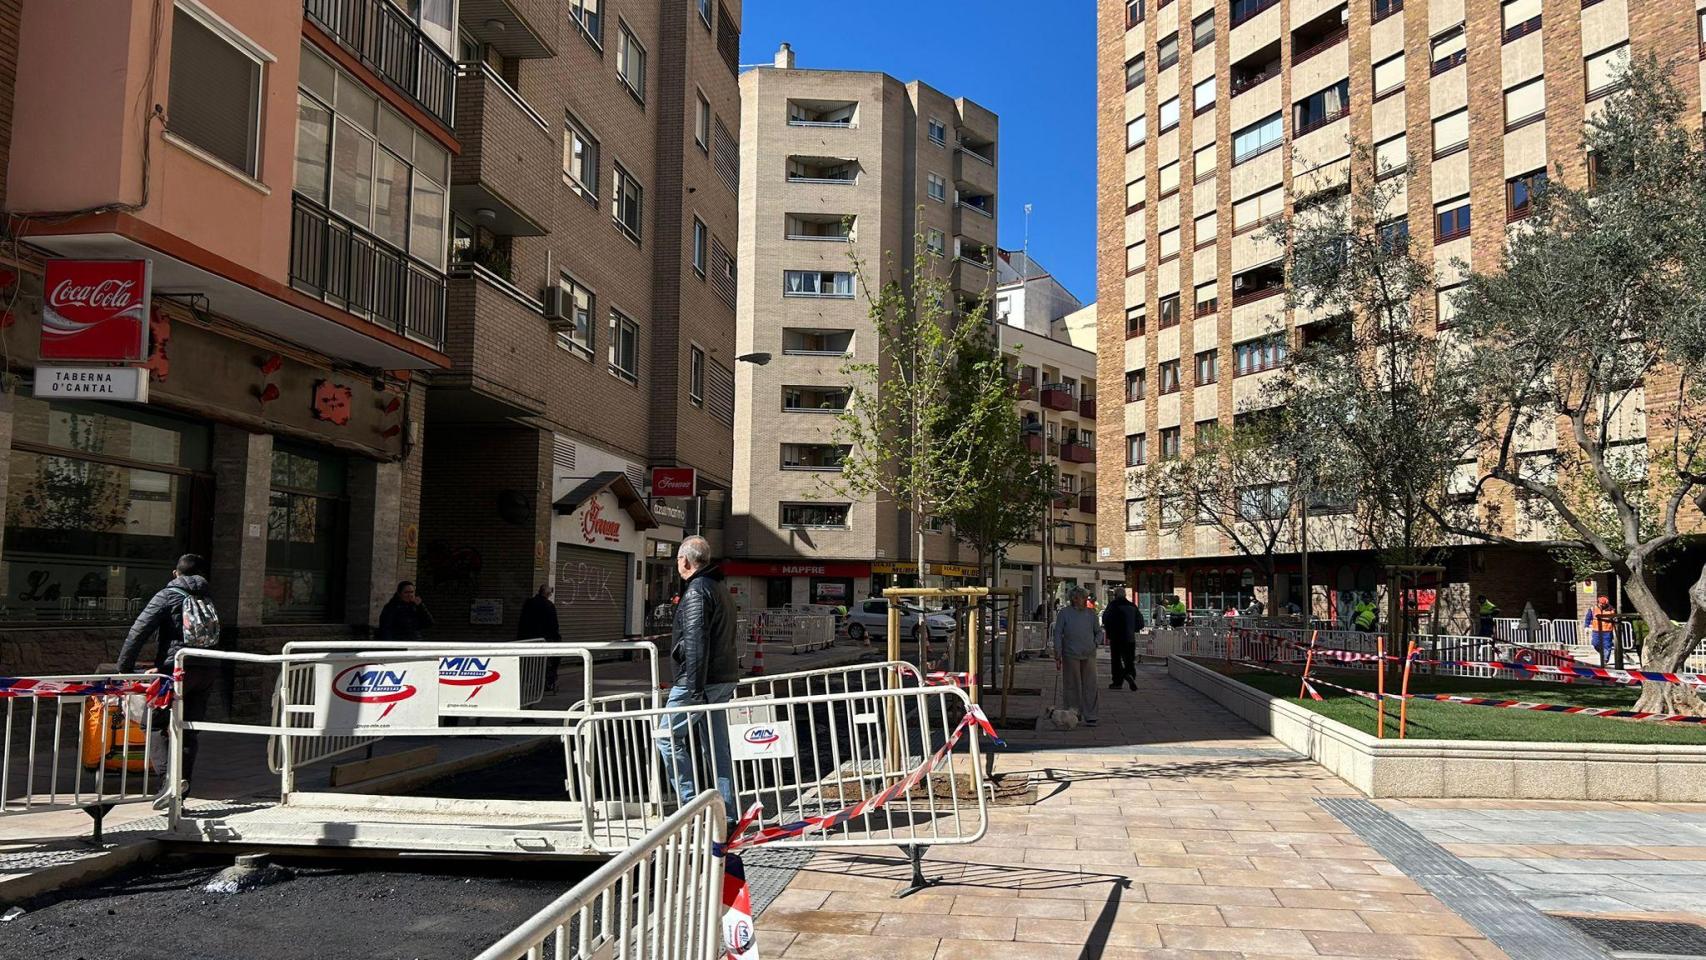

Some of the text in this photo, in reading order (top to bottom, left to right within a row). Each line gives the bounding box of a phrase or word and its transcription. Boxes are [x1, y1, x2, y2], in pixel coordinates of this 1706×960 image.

[49, 279, 137, 307] Coca-Cola
[55, 371, 113, 382] TABERNA
[52, 383, 114, 394] O'CANTAL
[782, 566, 825, 574] MAPFRE
